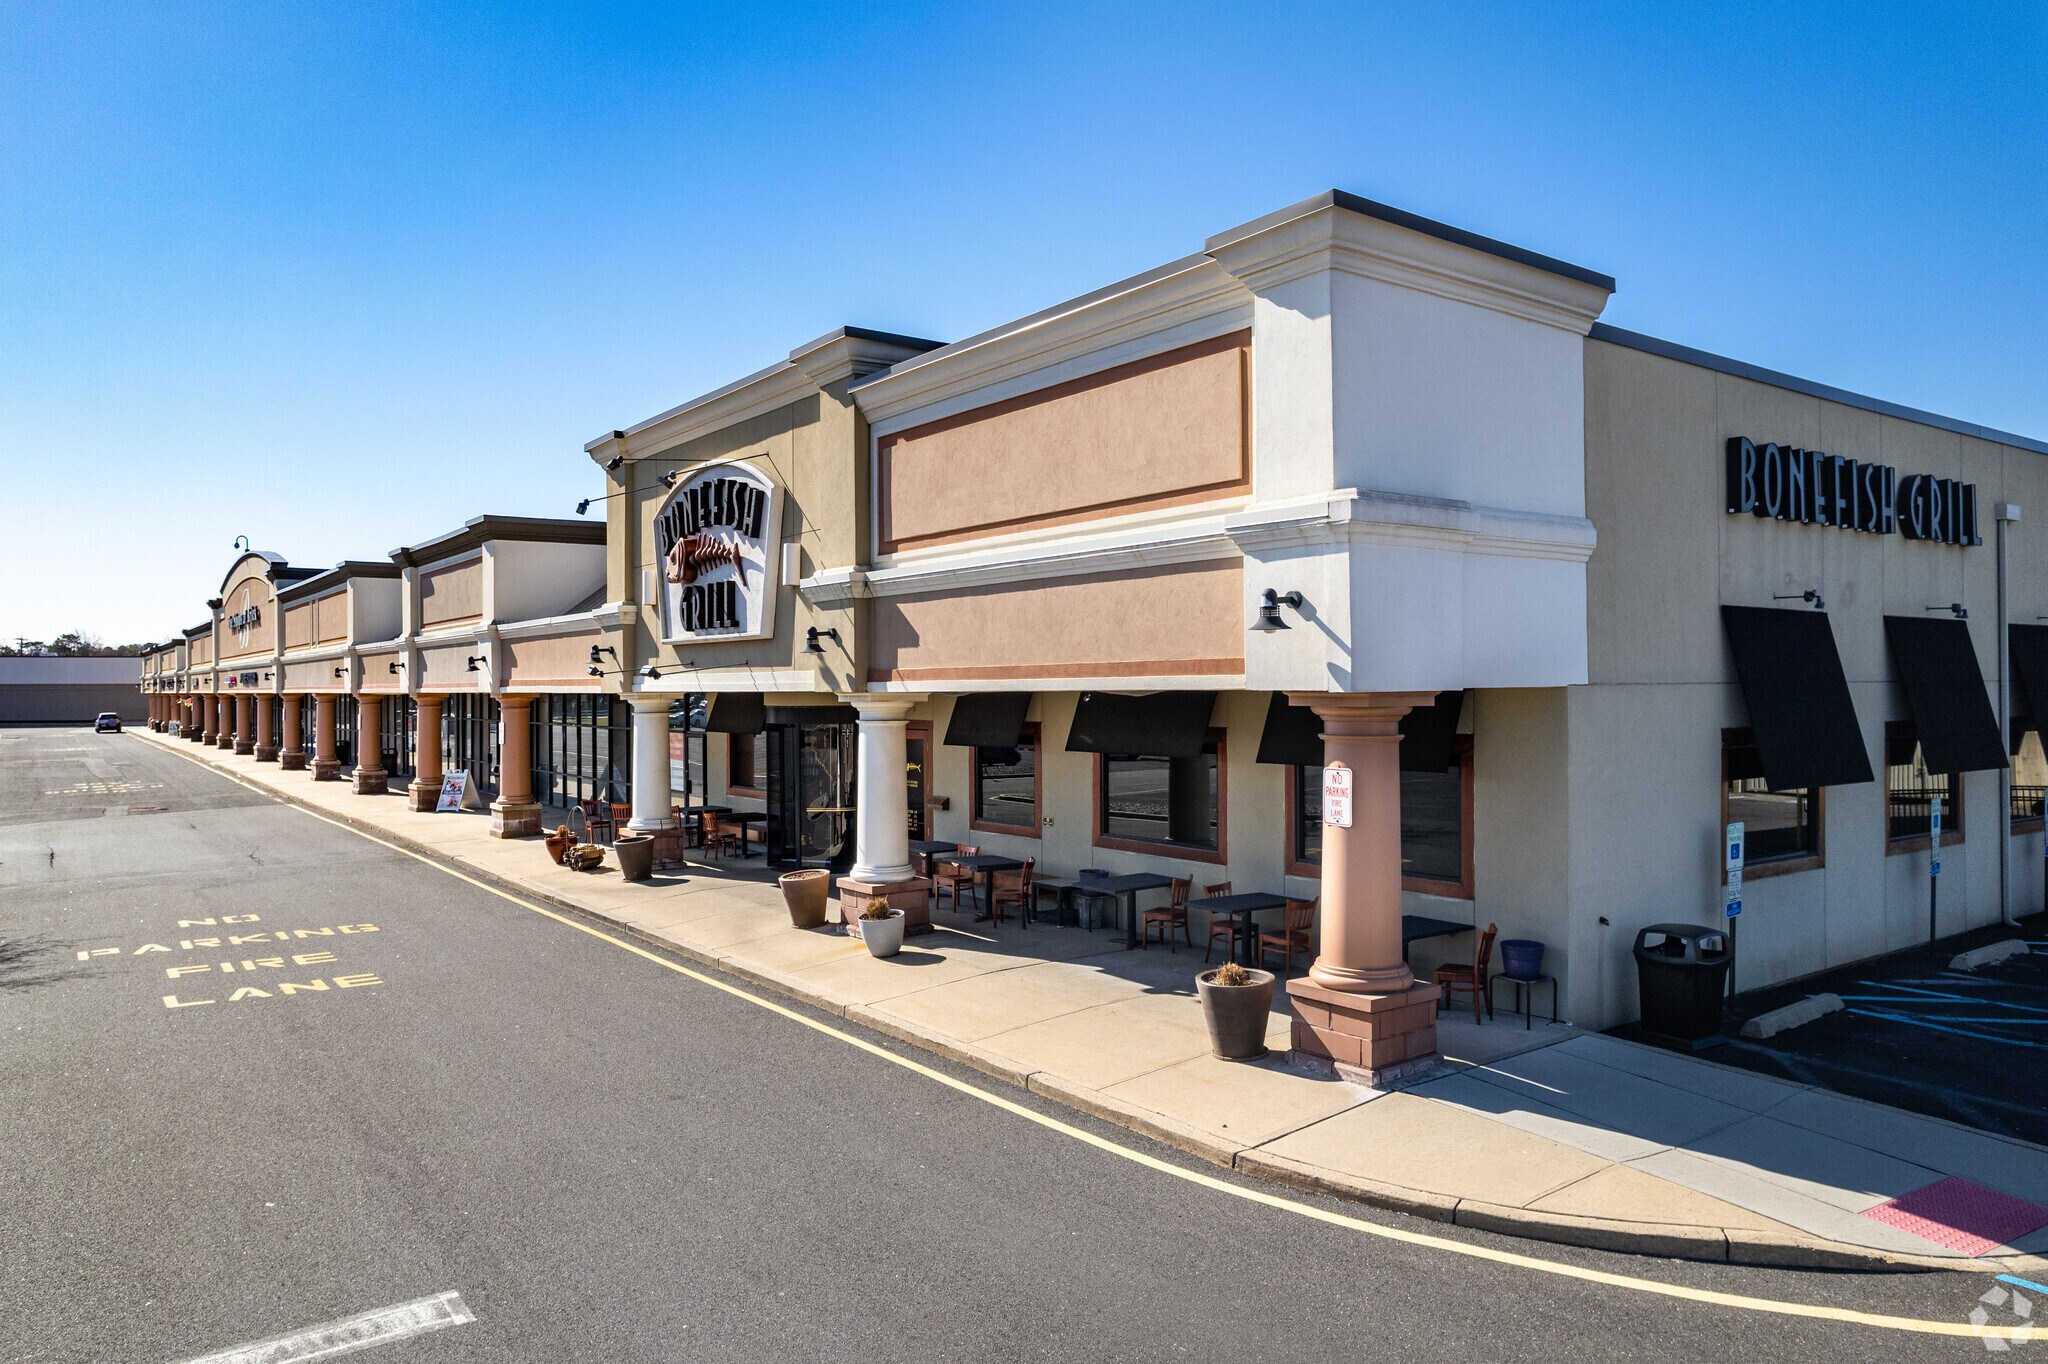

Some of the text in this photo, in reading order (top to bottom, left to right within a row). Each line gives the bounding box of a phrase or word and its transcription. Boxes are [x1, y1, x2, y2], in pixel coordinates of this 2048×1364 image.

[1727, 436, 1982, 546] BONEFISH GRILL
[658, 478, 765, 556] BONEFISH
[679, 580, 740, 632] GRILL
[1325, 786, 1349, 798] PARKING
[1331, 774, 1343, 785] NO
[1330, 809, 1344, 818] LANE
[177, 913, 261, 928] NO
[77, 923, 380, 961] PARKING
[166, 951, 338, 979] FIRE
[162, 973, 384, 1008] LANE
